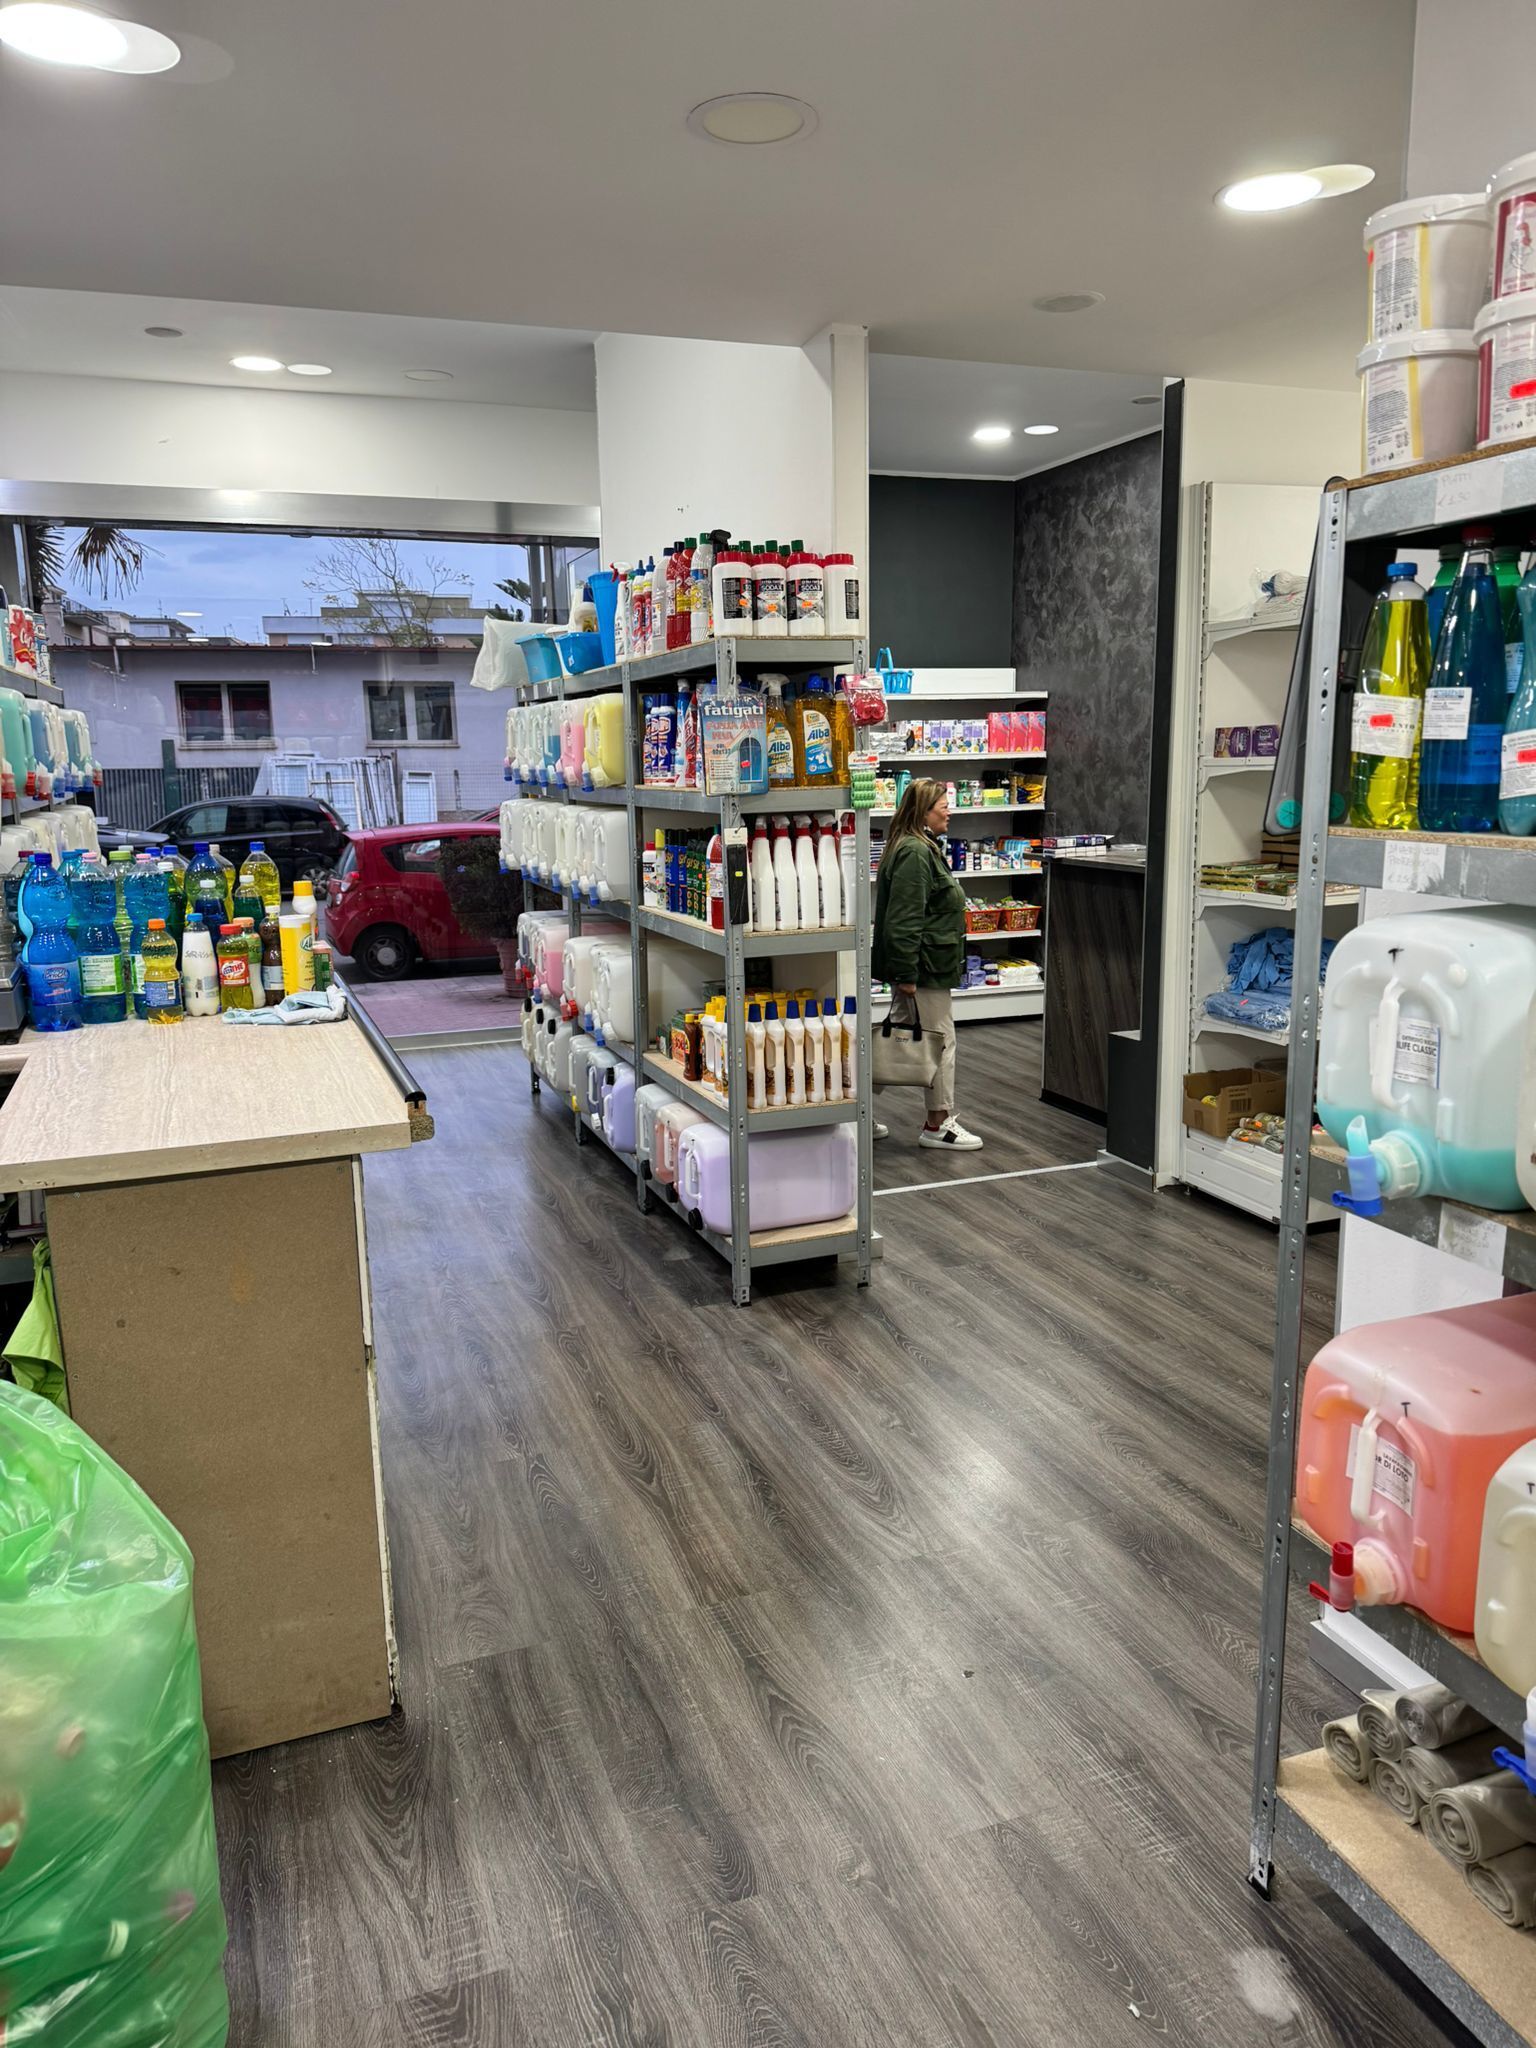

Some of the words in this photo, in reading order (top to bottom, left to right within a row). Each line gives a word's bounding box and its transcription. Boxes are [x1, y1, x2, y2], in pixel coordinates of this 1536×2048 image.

[704, 703, 764, 718] fatigati
[807, 728, 830, 742] Alba
[768, 742, 791, 753] Alba
[1412, 1044, 1437, 1057] CLASSIC
[1401, 1401, 1411, 1418] T
[1383, 1460, 1391, 1470] DI
[1392, 1464, 1409, 1482] LOTO
[1526, 1482, 1536, 1495] T
